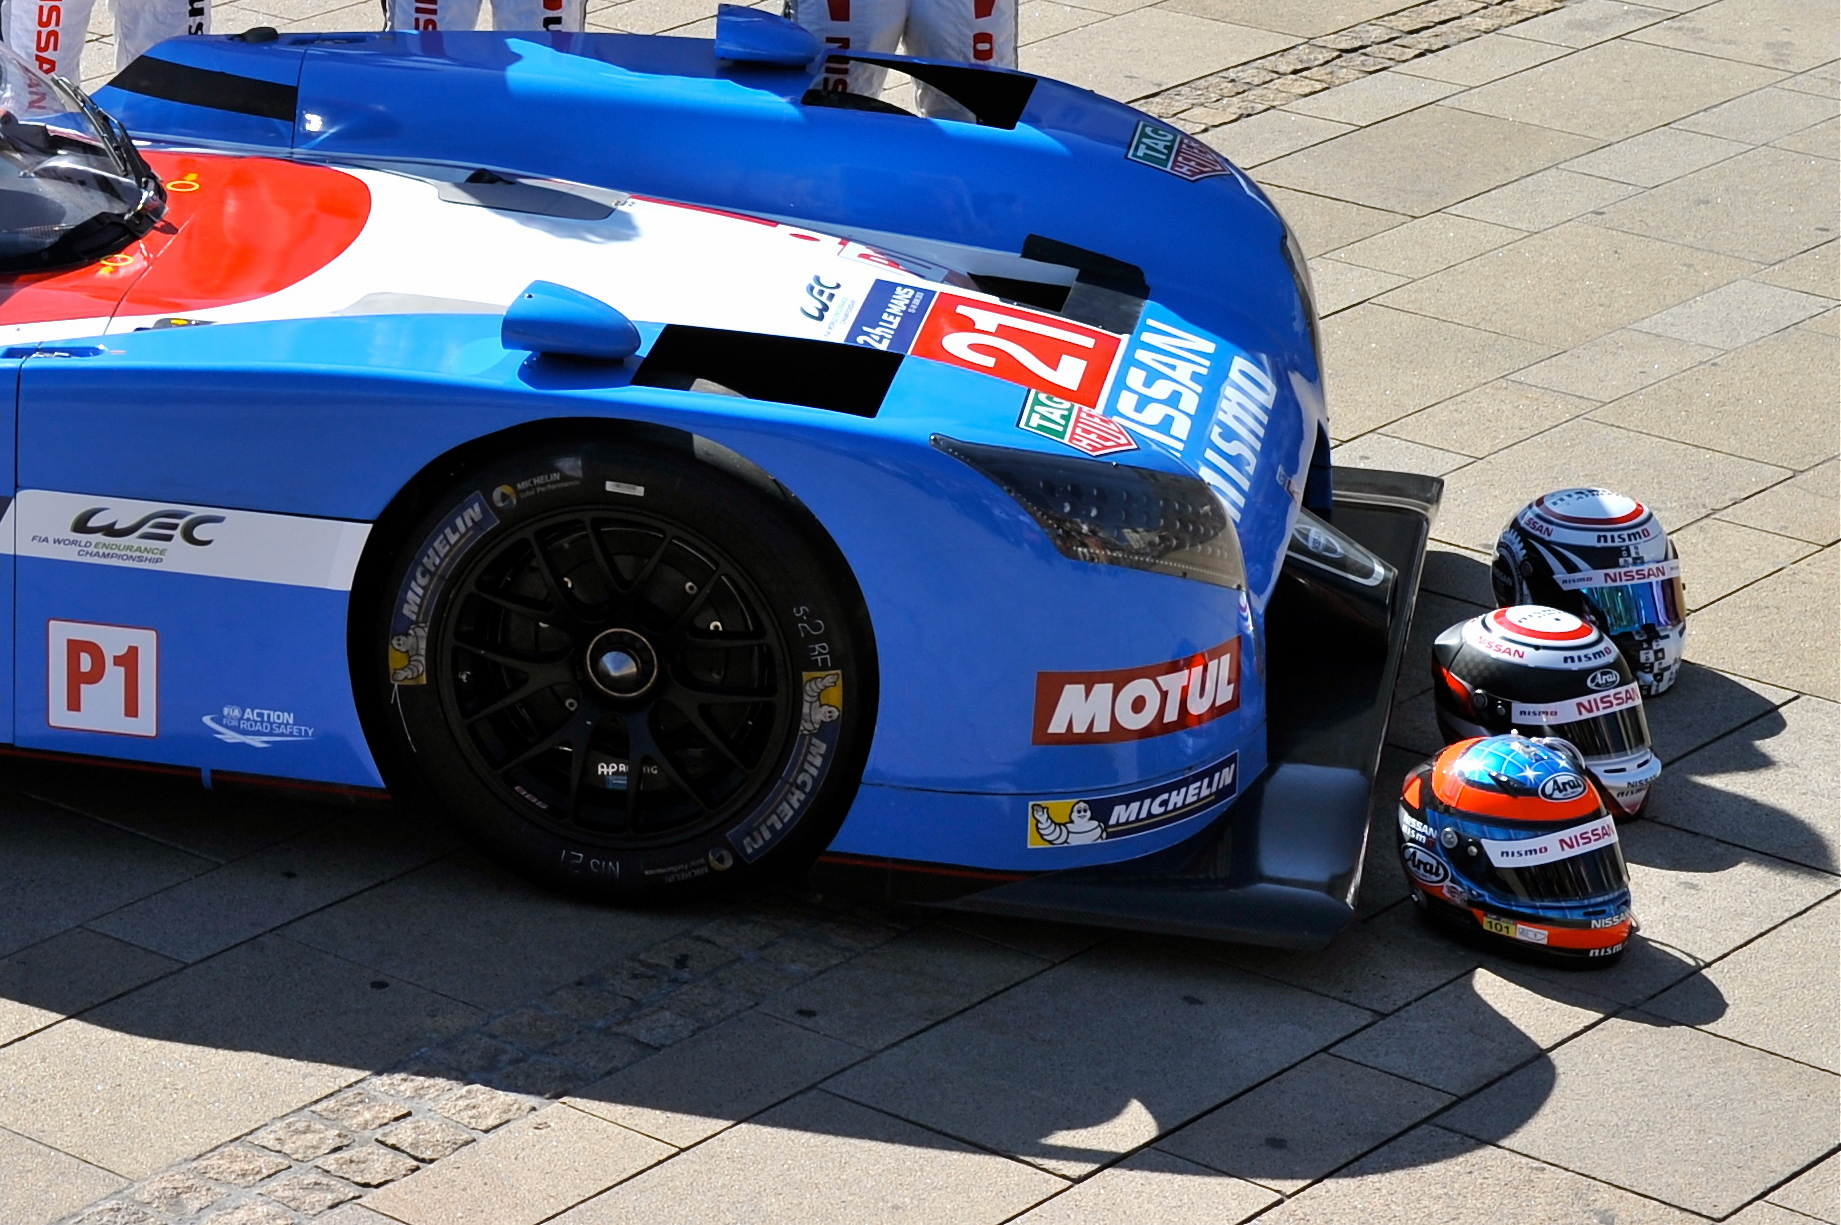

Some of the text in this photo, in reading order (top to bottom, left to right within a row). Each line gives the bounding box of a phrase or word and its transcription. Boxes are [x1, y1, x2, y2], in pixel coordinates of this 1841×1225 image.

[1136, 126, 1175, 160] TAG
[800, 275, 842, 323] WEC
[942, 304, 1097, 391] 21
[1113, 318, 1216, 458] ISSAN
[1028, 392, 1073, 432] TAG
[70, 506, 227, 548] WEC
[1596, 527, 1652, 545] nismo
[30, 534, 168, 557] FIA WORLD ENDURANCE
[76, 548, 164, 565] CHAMPIONSHIP
[402, 501, 484, 623] MICHELIN
[1561, 576, 1594, 585] nismo
[1603, 565, 1667, 584] NISSAN
[1562, 645, 1613, 665] nismo
[65, 637, 141, 719] P1
[1047, 653, 1235, 734] MOTUL
[1591, 670, 1619, 688] Arai
[223, 706, 295, 725] FIA ACTION
[1519, 685, 1642, 718] nismo NISSAN
[222, 718, 315, 737] FOR ROAD SAFETY
[742, 736, 829, 856] MICHELIN
[1109, 763, 1236, 826] MICHELIN
[1549, 775, 1584, 797] Arai
[1402, 813, 1438, 839] NISSAN
[1500, 822, 1615, 859] nismo NISSAN
[1406, 850, 1443, 879] Arai
[1487, 918, 1511, 935] 101
